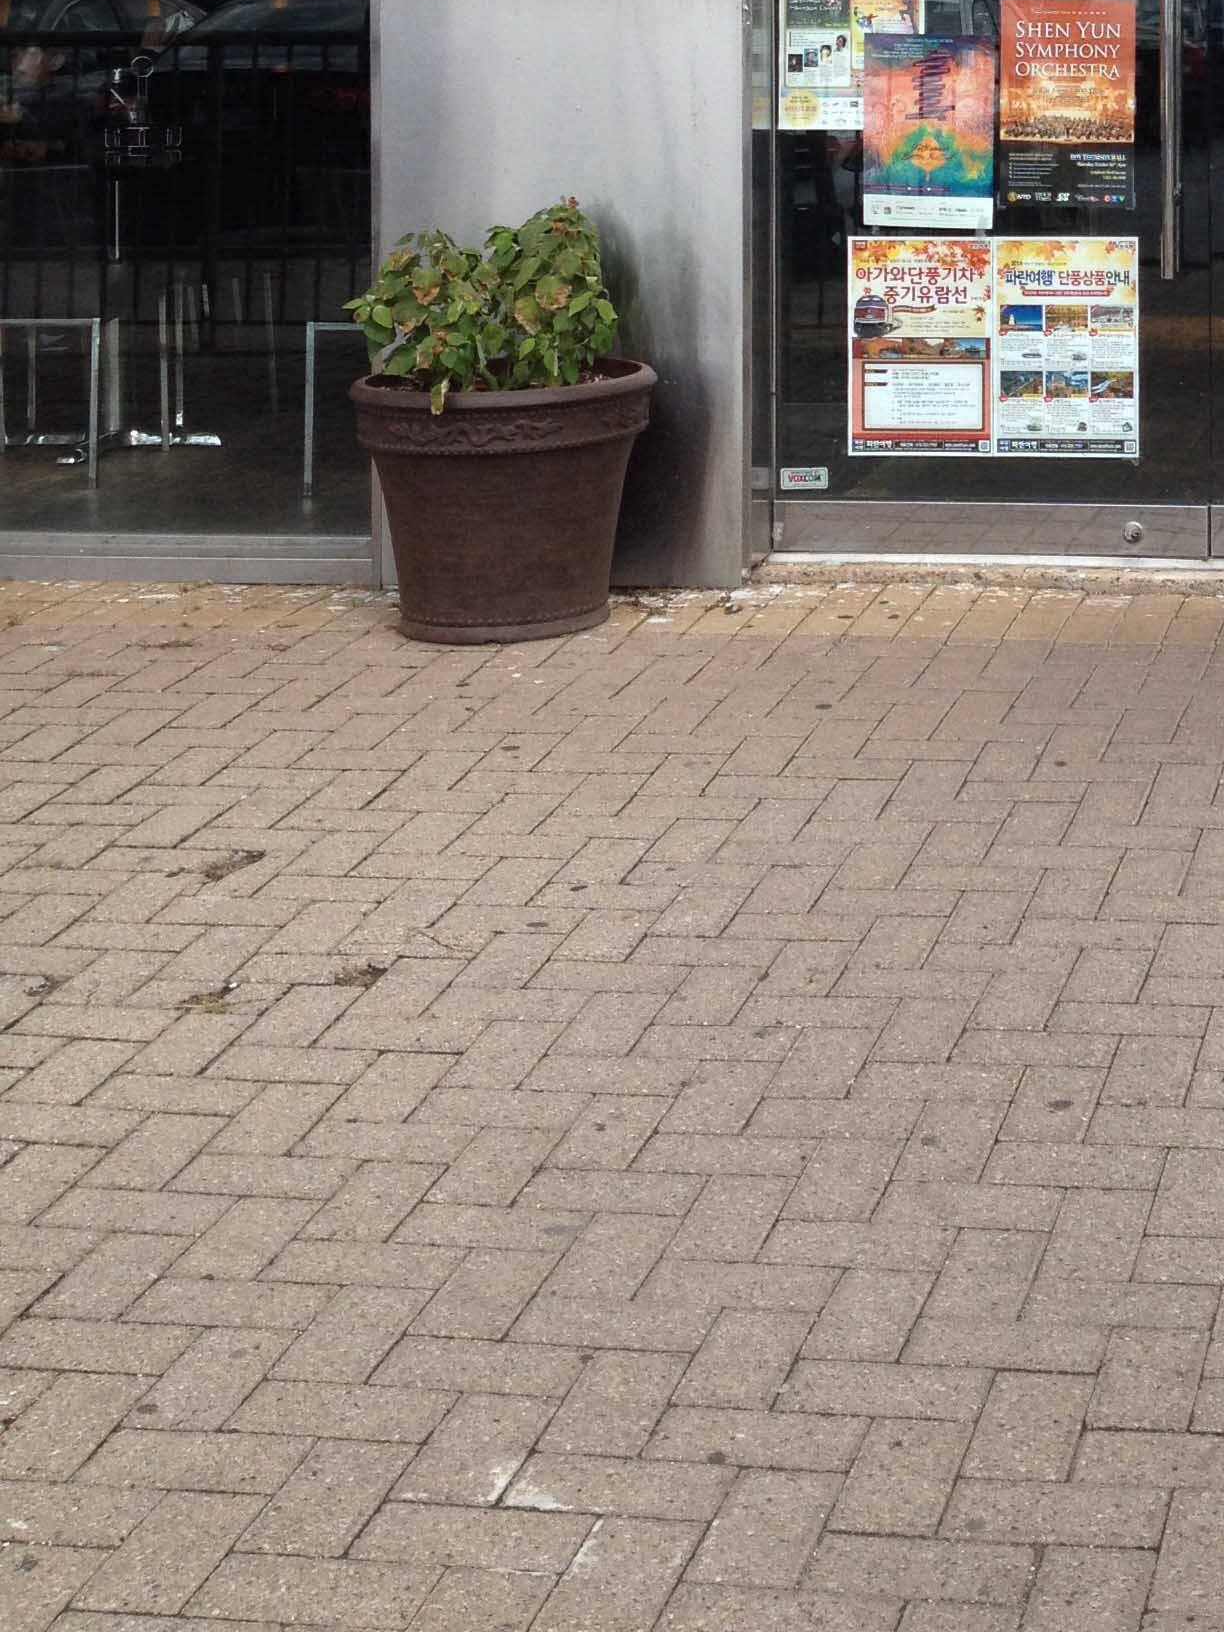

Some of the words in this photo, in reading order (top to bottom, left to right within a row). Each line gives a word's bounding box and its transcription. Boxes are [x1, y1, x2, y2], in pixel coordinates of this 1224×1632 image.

[1015, 20, 1070, 39] SHEN
[1076, 21, 1121, 39] YUN
[1015, 41, 1120, 58] SYMPHONY
[1015, 61, 1120, 80] ORCHESTRA
